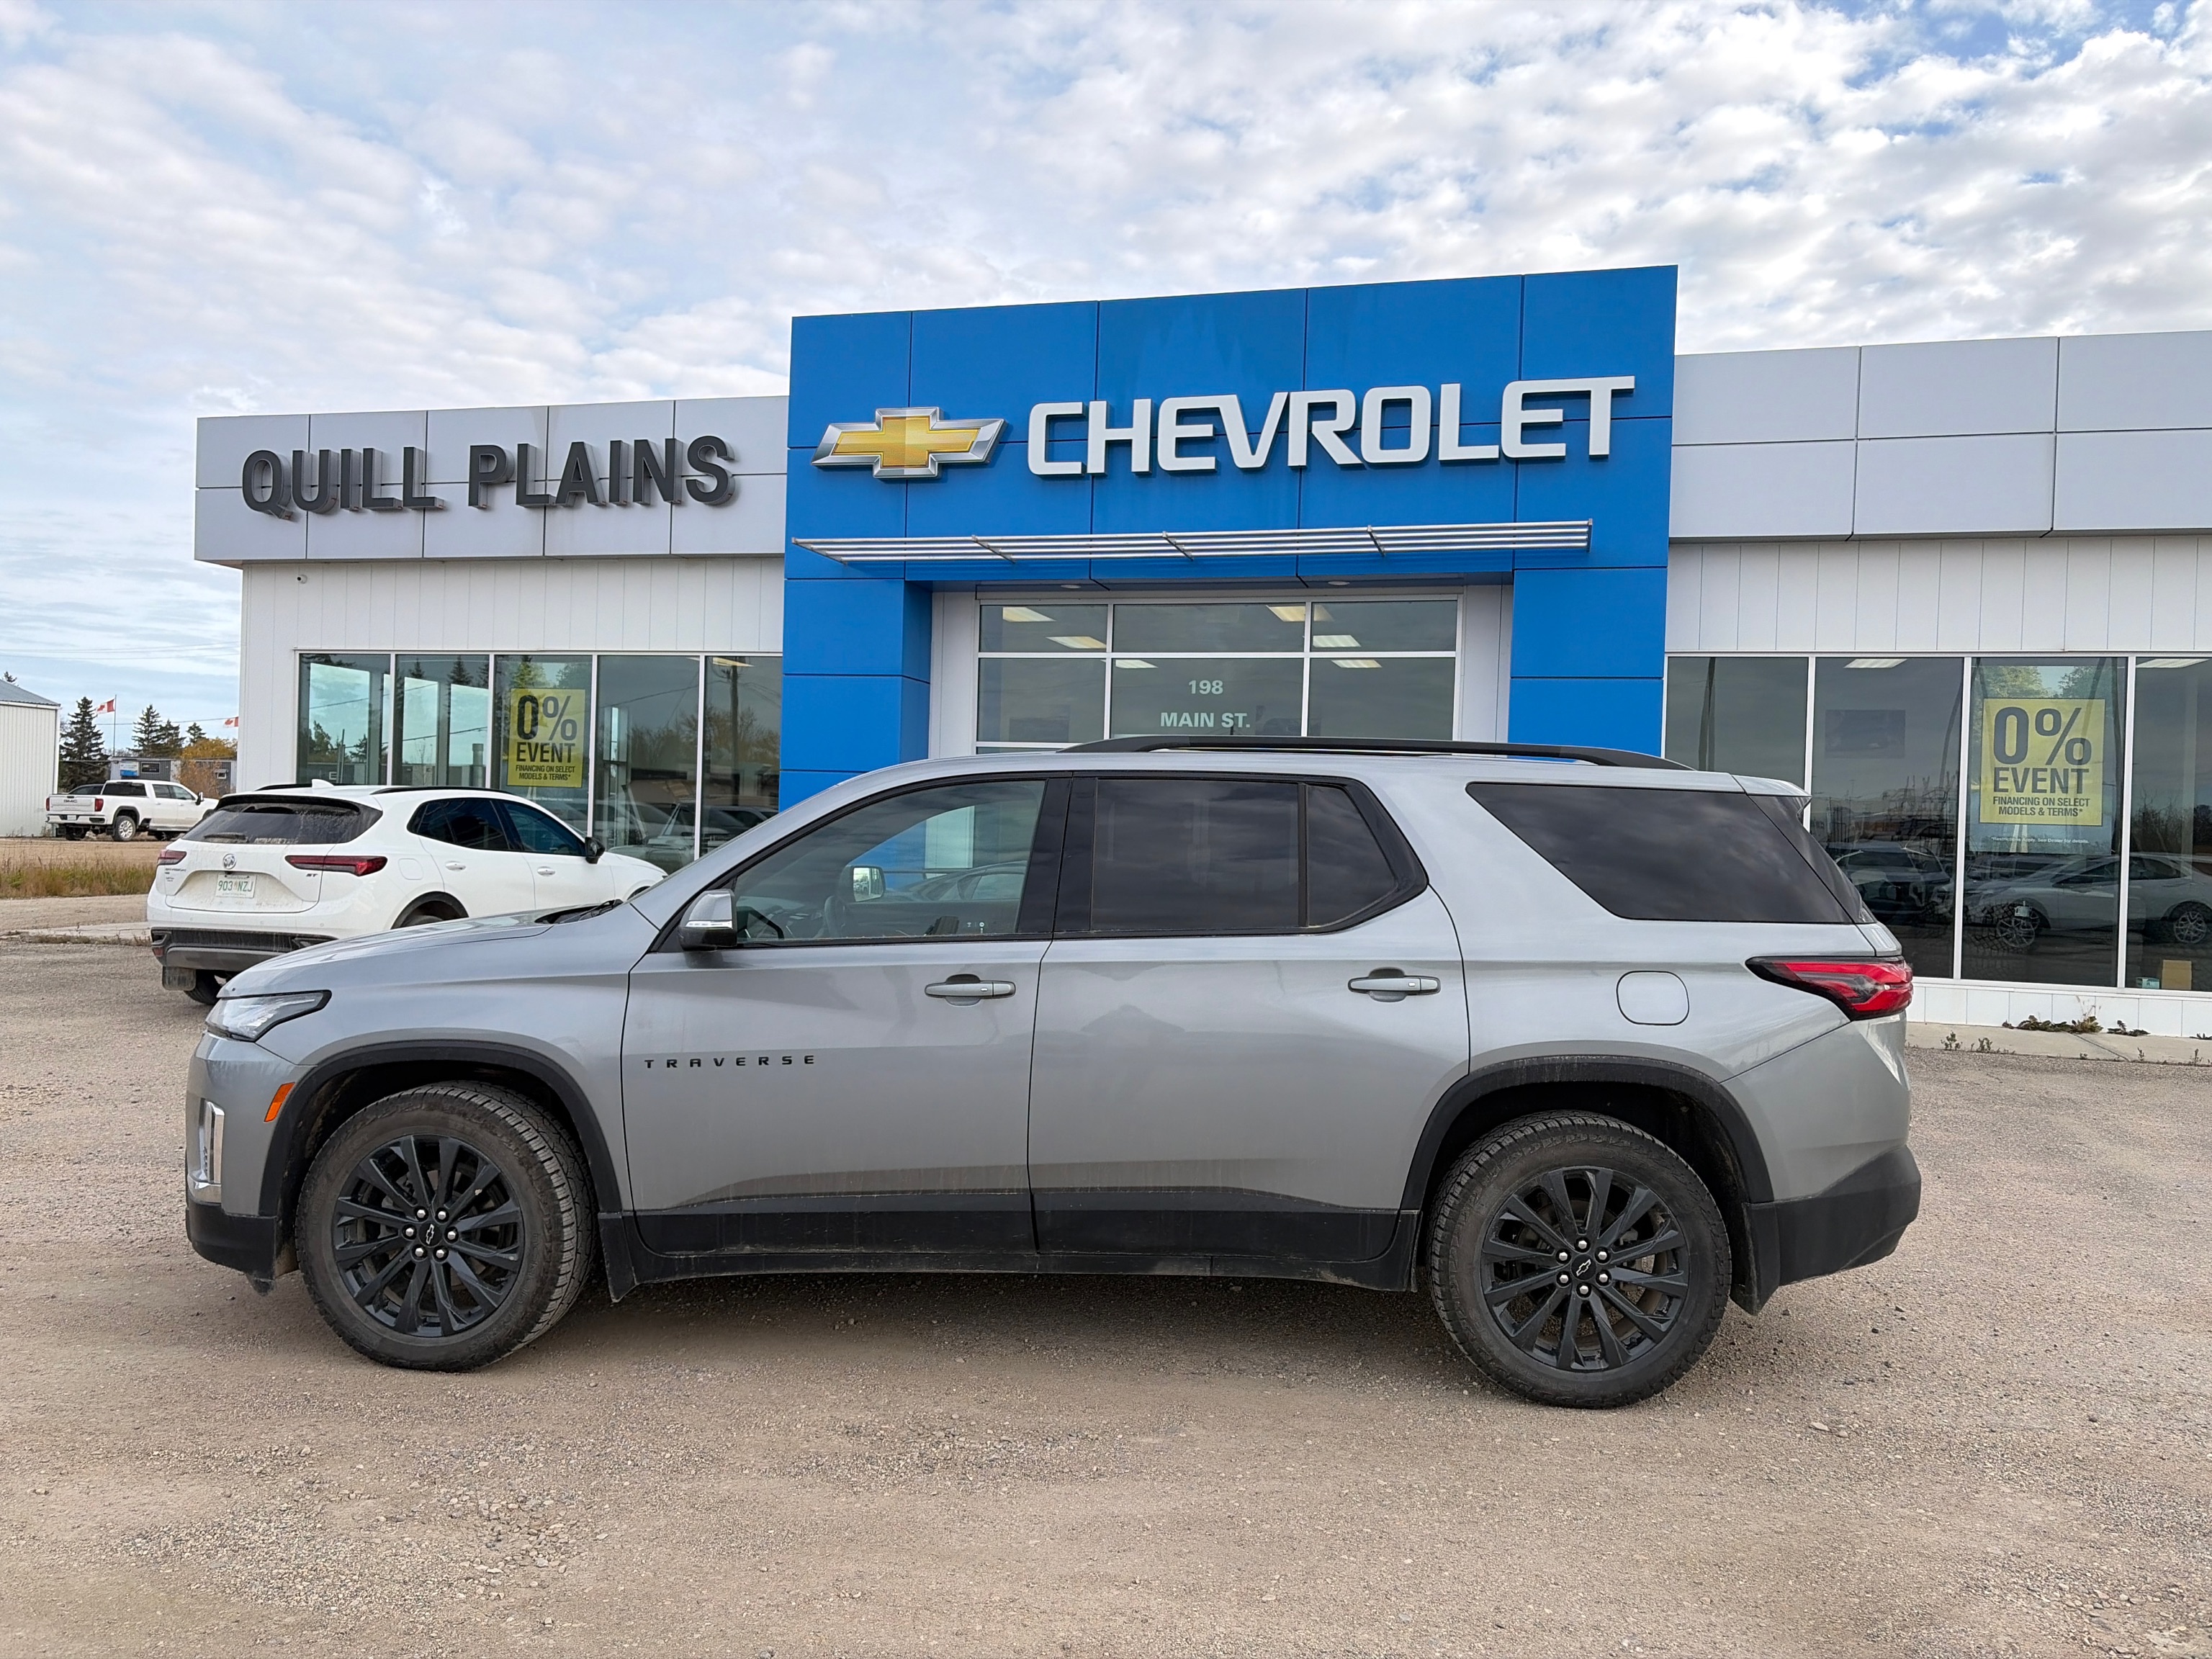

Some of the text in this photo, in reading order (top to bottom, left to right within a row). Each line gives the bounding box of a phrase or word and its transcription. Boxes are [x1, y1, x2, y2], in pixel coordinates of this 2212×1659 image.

[1028, 375, 1636, 476] CHEVROLET
[240, 435, 735, 520] QUILL PLAINS
[1188, 680, 1223, 695] 198
[516, 694, 577, 741] 0%
[1160, 712, 1251, 728] MAIN ST.
[1993, 706, 2092, 765] 0%
[516, 742, 575, 763] EVENT
[1993, 767, 2090, 794] EVENT
[1992, 796, 2090, 806] FINANCING ON SELECT
[1998, 806, 2036, 816] MODELS
[2038, 807, 2045, 816] &
[218, 880, 253, 892] 903 NZJ
[644, 1055, 814, 1069] TRAVERSE
